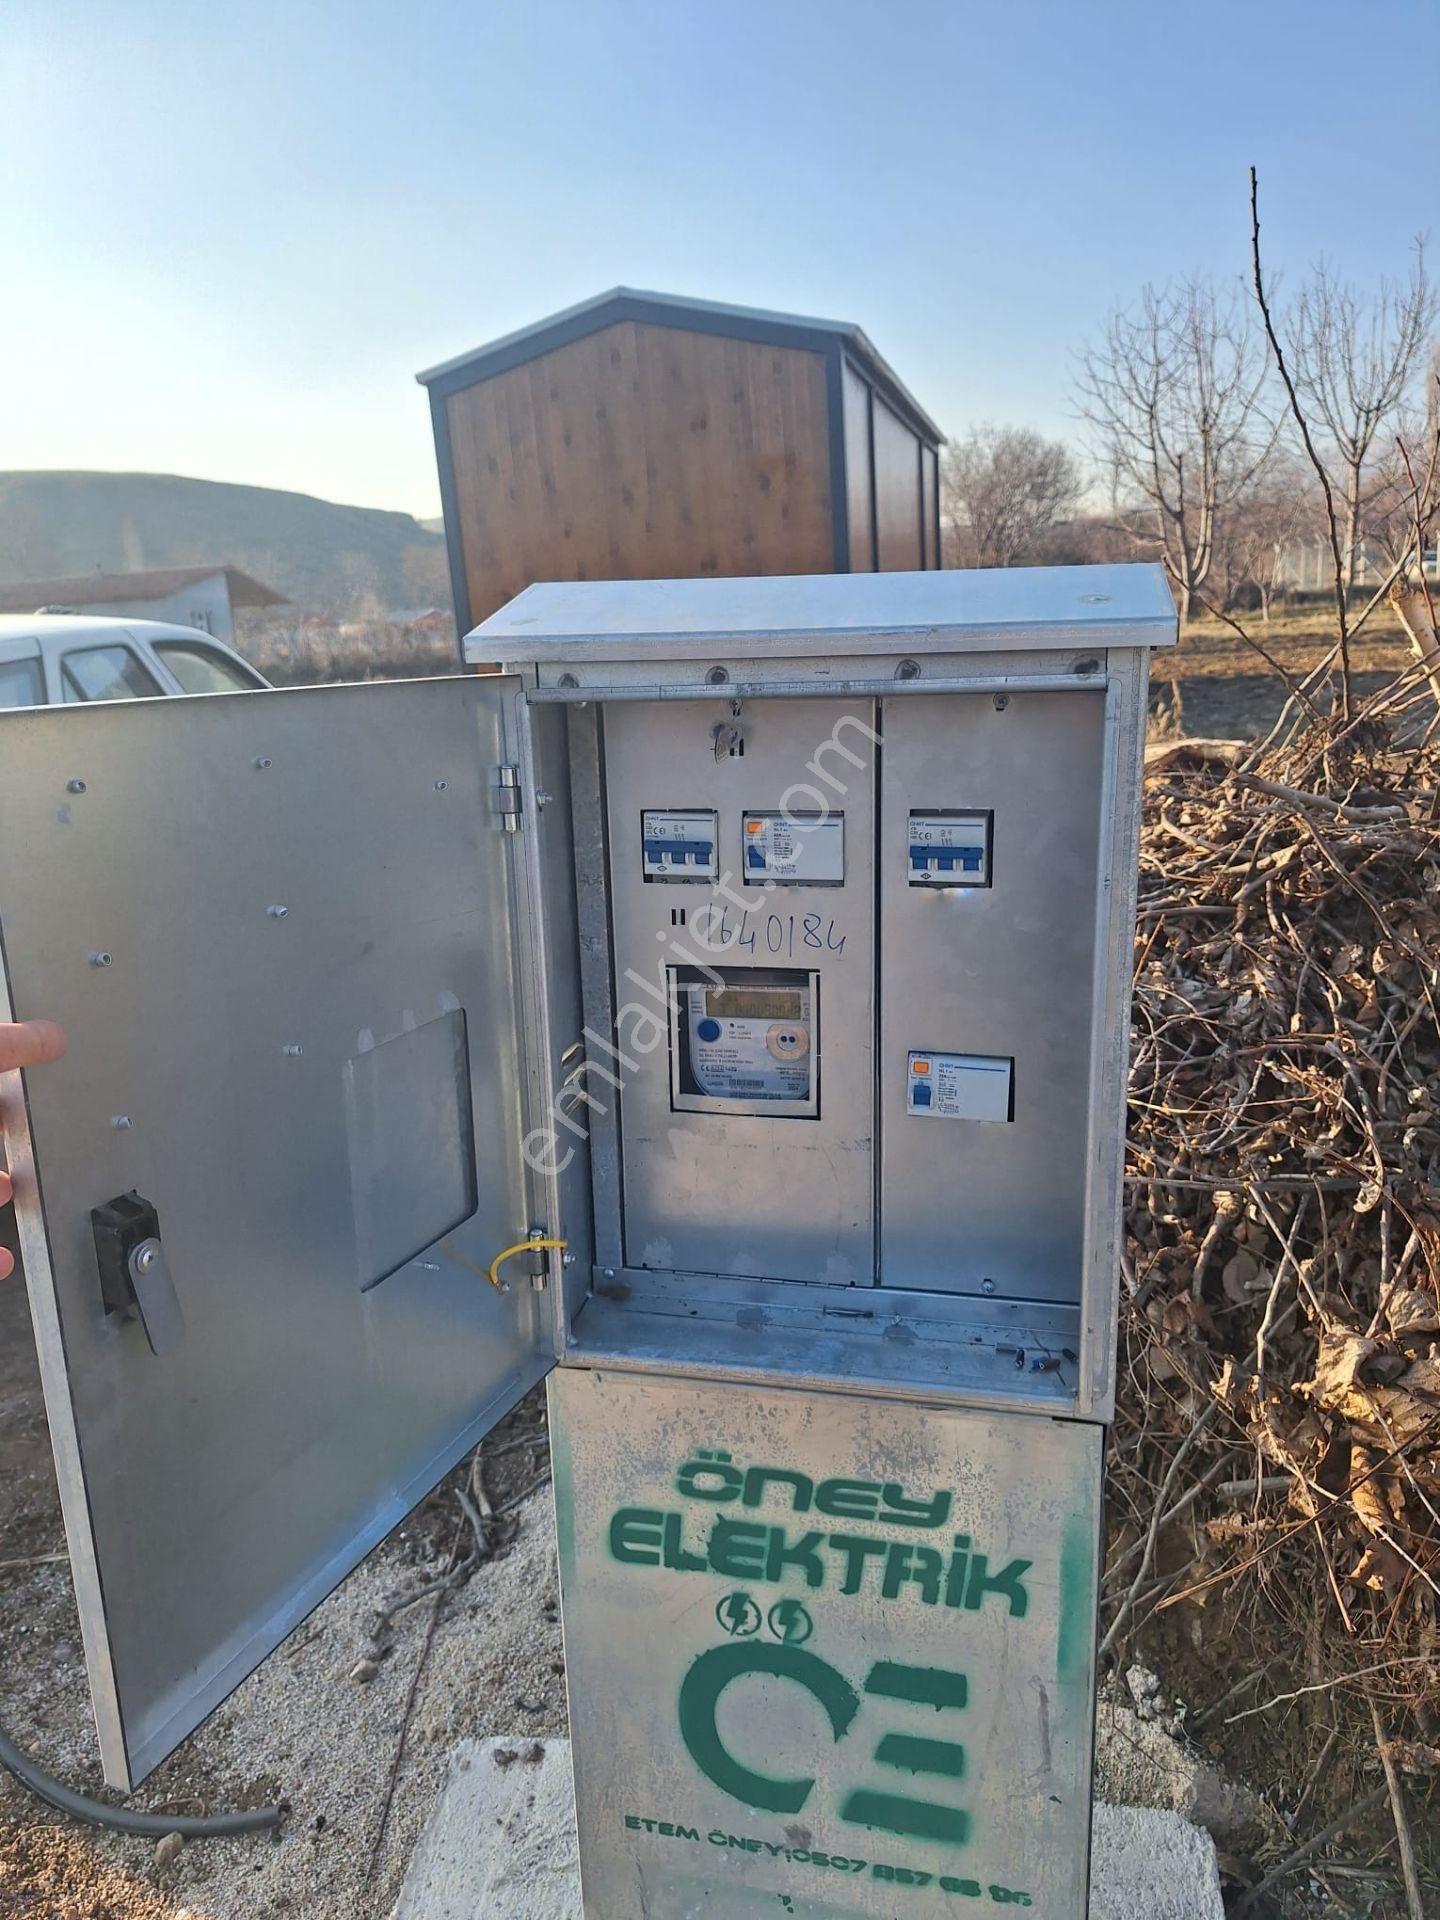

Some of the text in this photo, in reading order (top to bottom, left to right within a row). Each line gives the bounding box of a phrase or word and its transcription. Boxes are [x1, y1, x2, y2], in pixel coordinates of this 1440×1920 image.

[706, 902, 848, 959] 1640184
[608, 1506, 1034, 1619] ELEKTRİK
[624, 1814, 700, 1841] ETEM
